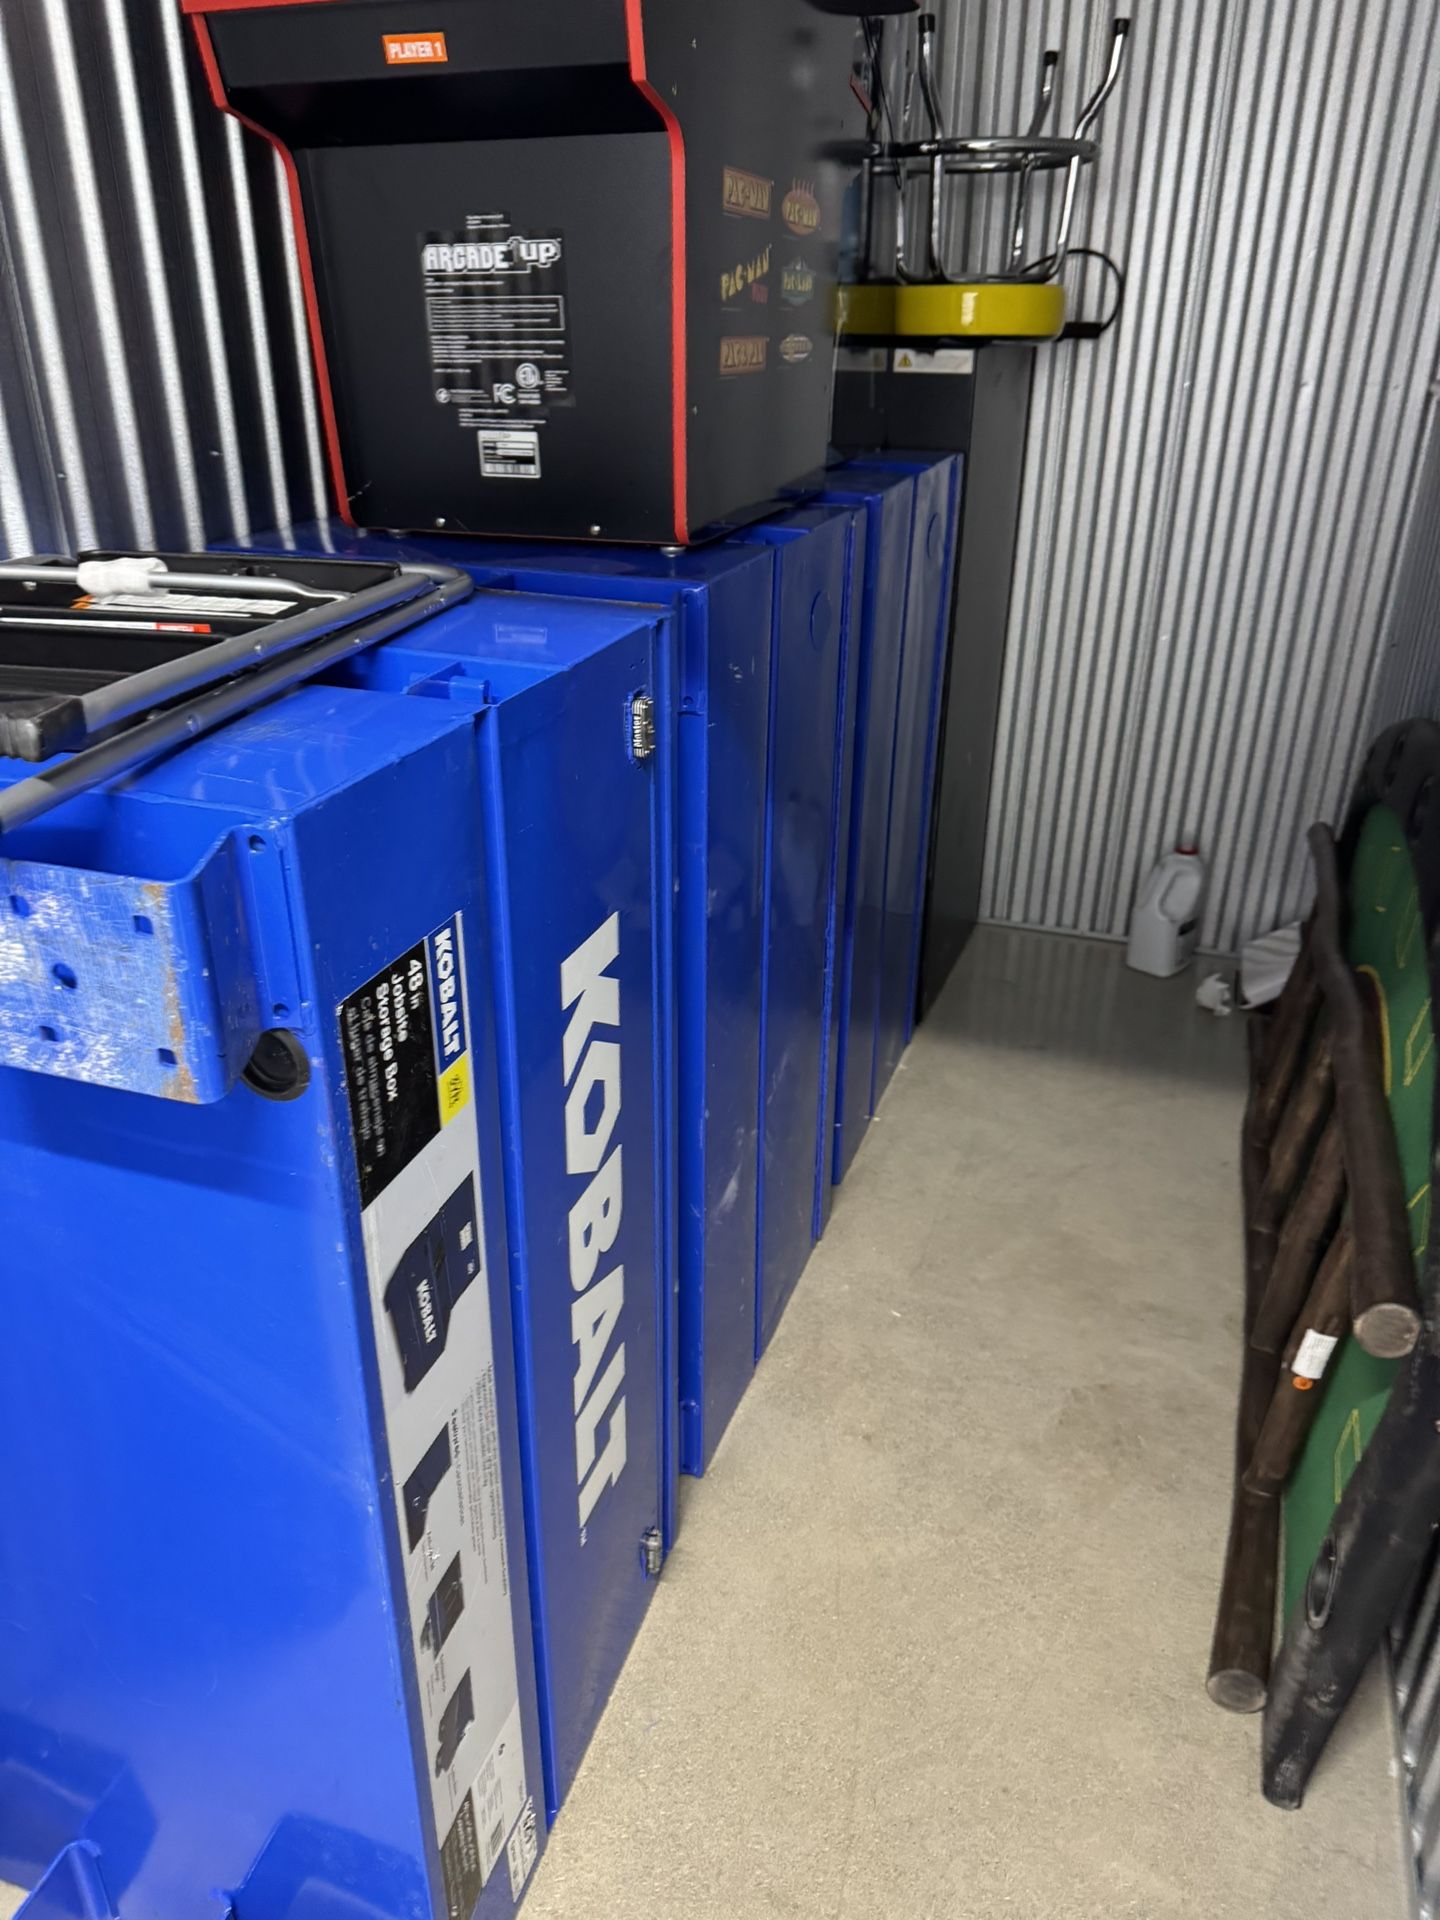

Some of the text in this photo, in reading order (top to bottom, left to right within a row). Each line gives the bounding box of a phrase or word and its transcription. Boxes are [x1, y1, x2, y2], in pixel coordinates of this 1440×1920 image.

[388, 41, 443, 58] PLAYER 1
[424, 244, 508, 273] ARCADE
[721, 247, 769, 302] PAC-MAN
[407, 959, 424, 992] 48
[434, 928, 461, 1058] KOBALT
[391, 975, 409, 1043] Jobsite
[376, 983, 399, 1103] Storage Box
[560, 911, 627, 1527] KOBALT
[416, 1278, 437, 1343] KOBALT
